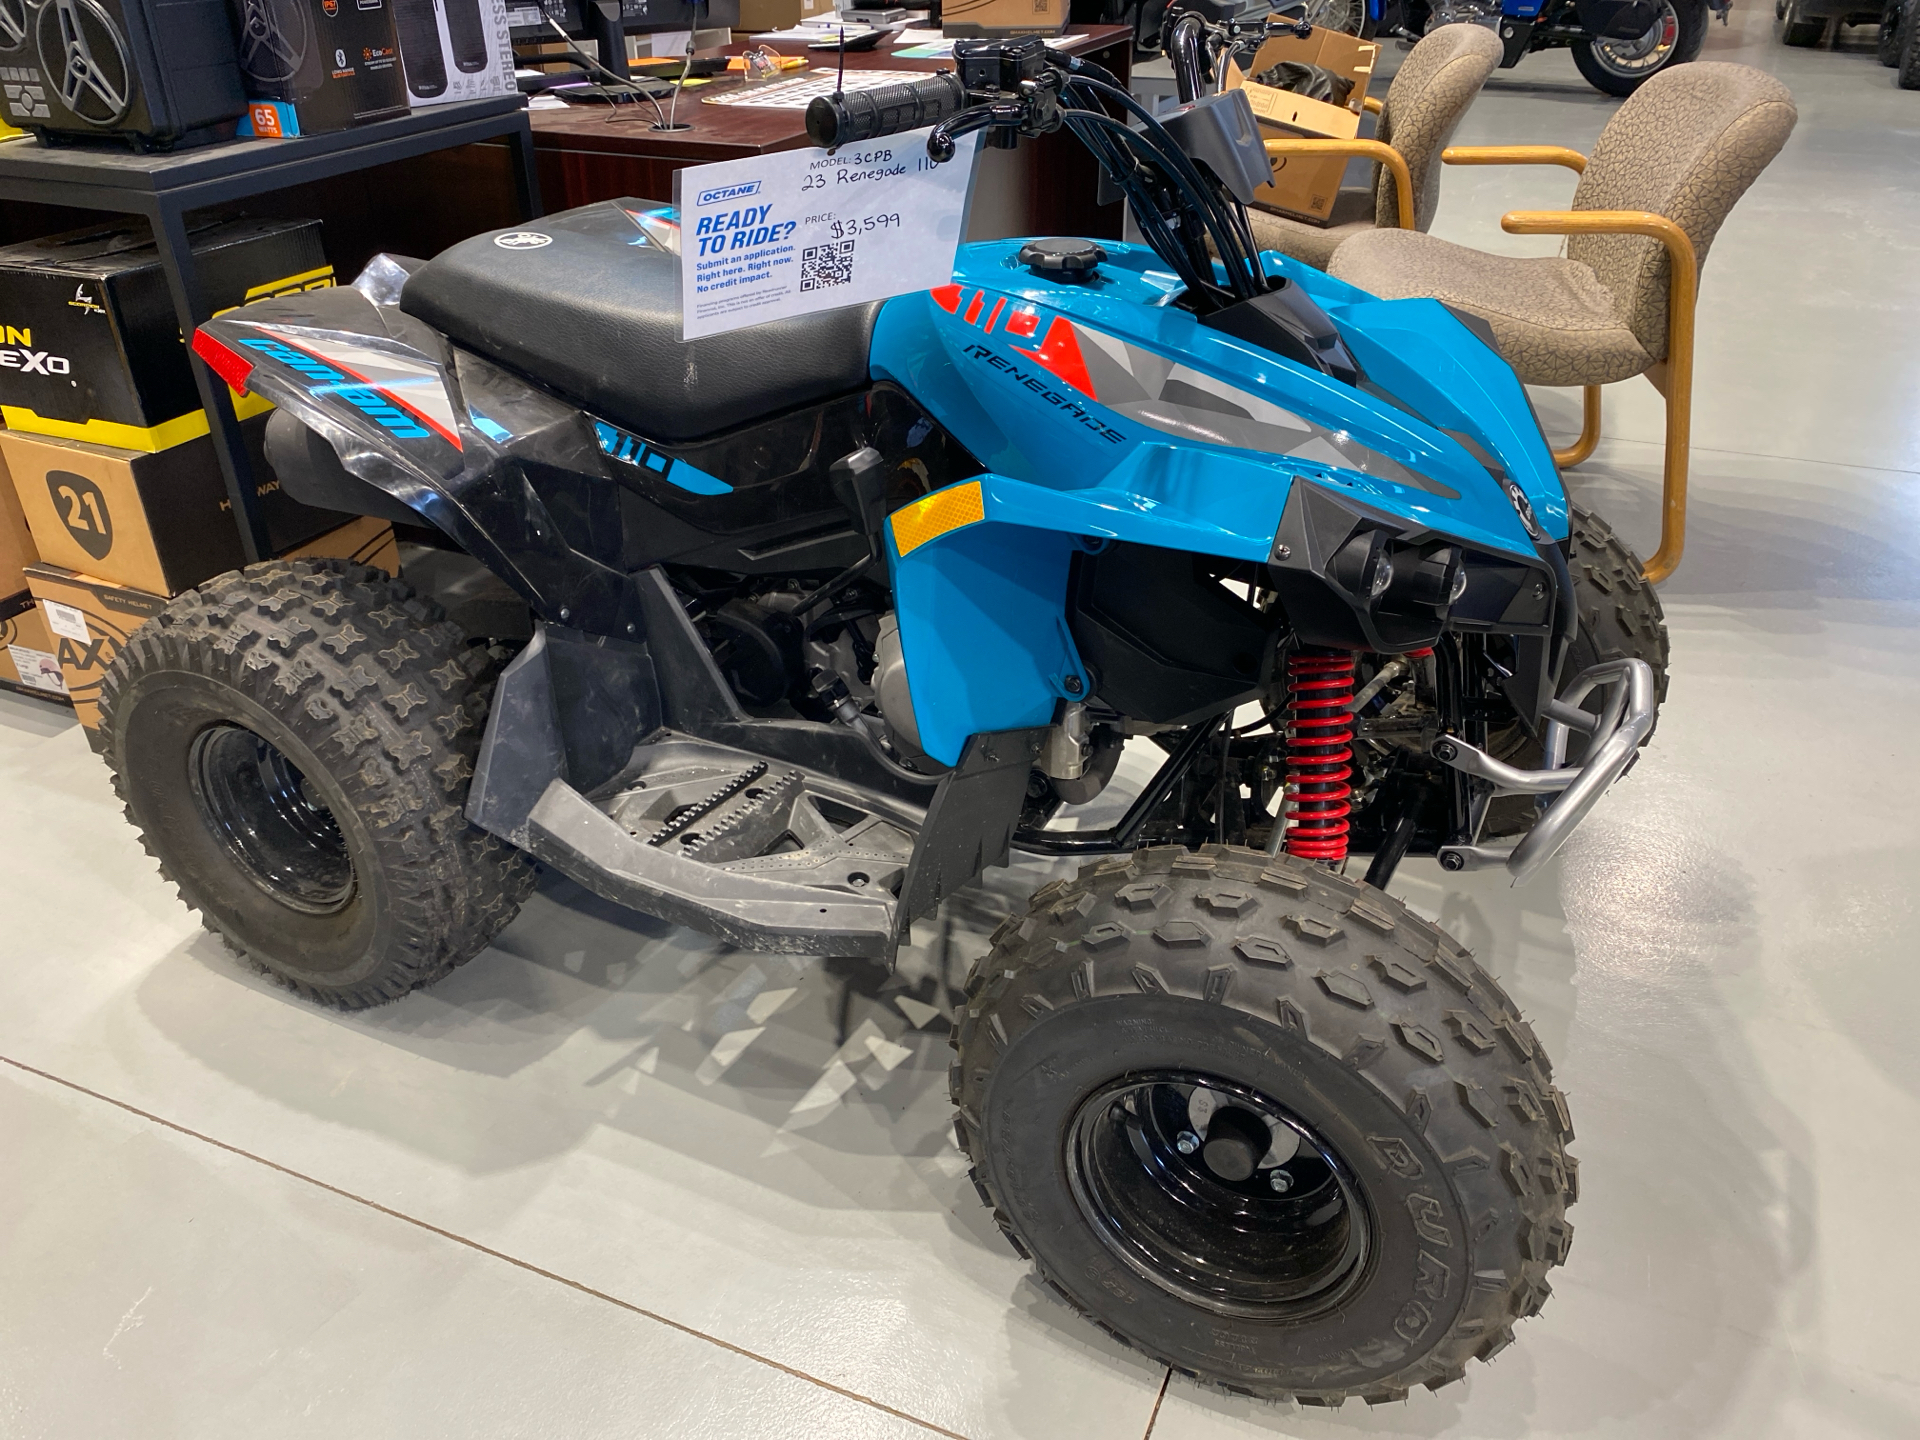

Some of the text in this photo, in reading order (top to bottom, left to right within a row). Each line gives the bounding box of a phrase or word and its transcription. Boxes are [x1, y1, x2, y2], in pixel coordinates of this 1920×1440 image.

[497, 30, 517, 91] STEREO
[254, 108, 275, 126] 65
[258, 126, 277, 134] WATTS
[809, 149, 893, 171] MODEL: 3CPB
[801, 174, 826, 192] 23
[836, 163, 907, 184] Renegade
[703, 185, 755, 201] OCTANE
[696, 203, 773, 236] READY
[805, 211, 837, 225] PRICE:
[830, 213, 900, 239] $3,599
[698, 221, 797, 257] TO RIDE?
[696, 245, 796, 271] Submit an application.
[696, 256, 794, 282] Right here. Right now.
[696, 271, 773, 294] No credit impact.
[0, 324, 32, 347] N
[963, 344, 1127, 444] RENEGADE
[58, 485, 107, 535] 21
[103, 594, 152, 610] SAFETY HELMET
[1366, 1136, 1454, 1347] DURO
